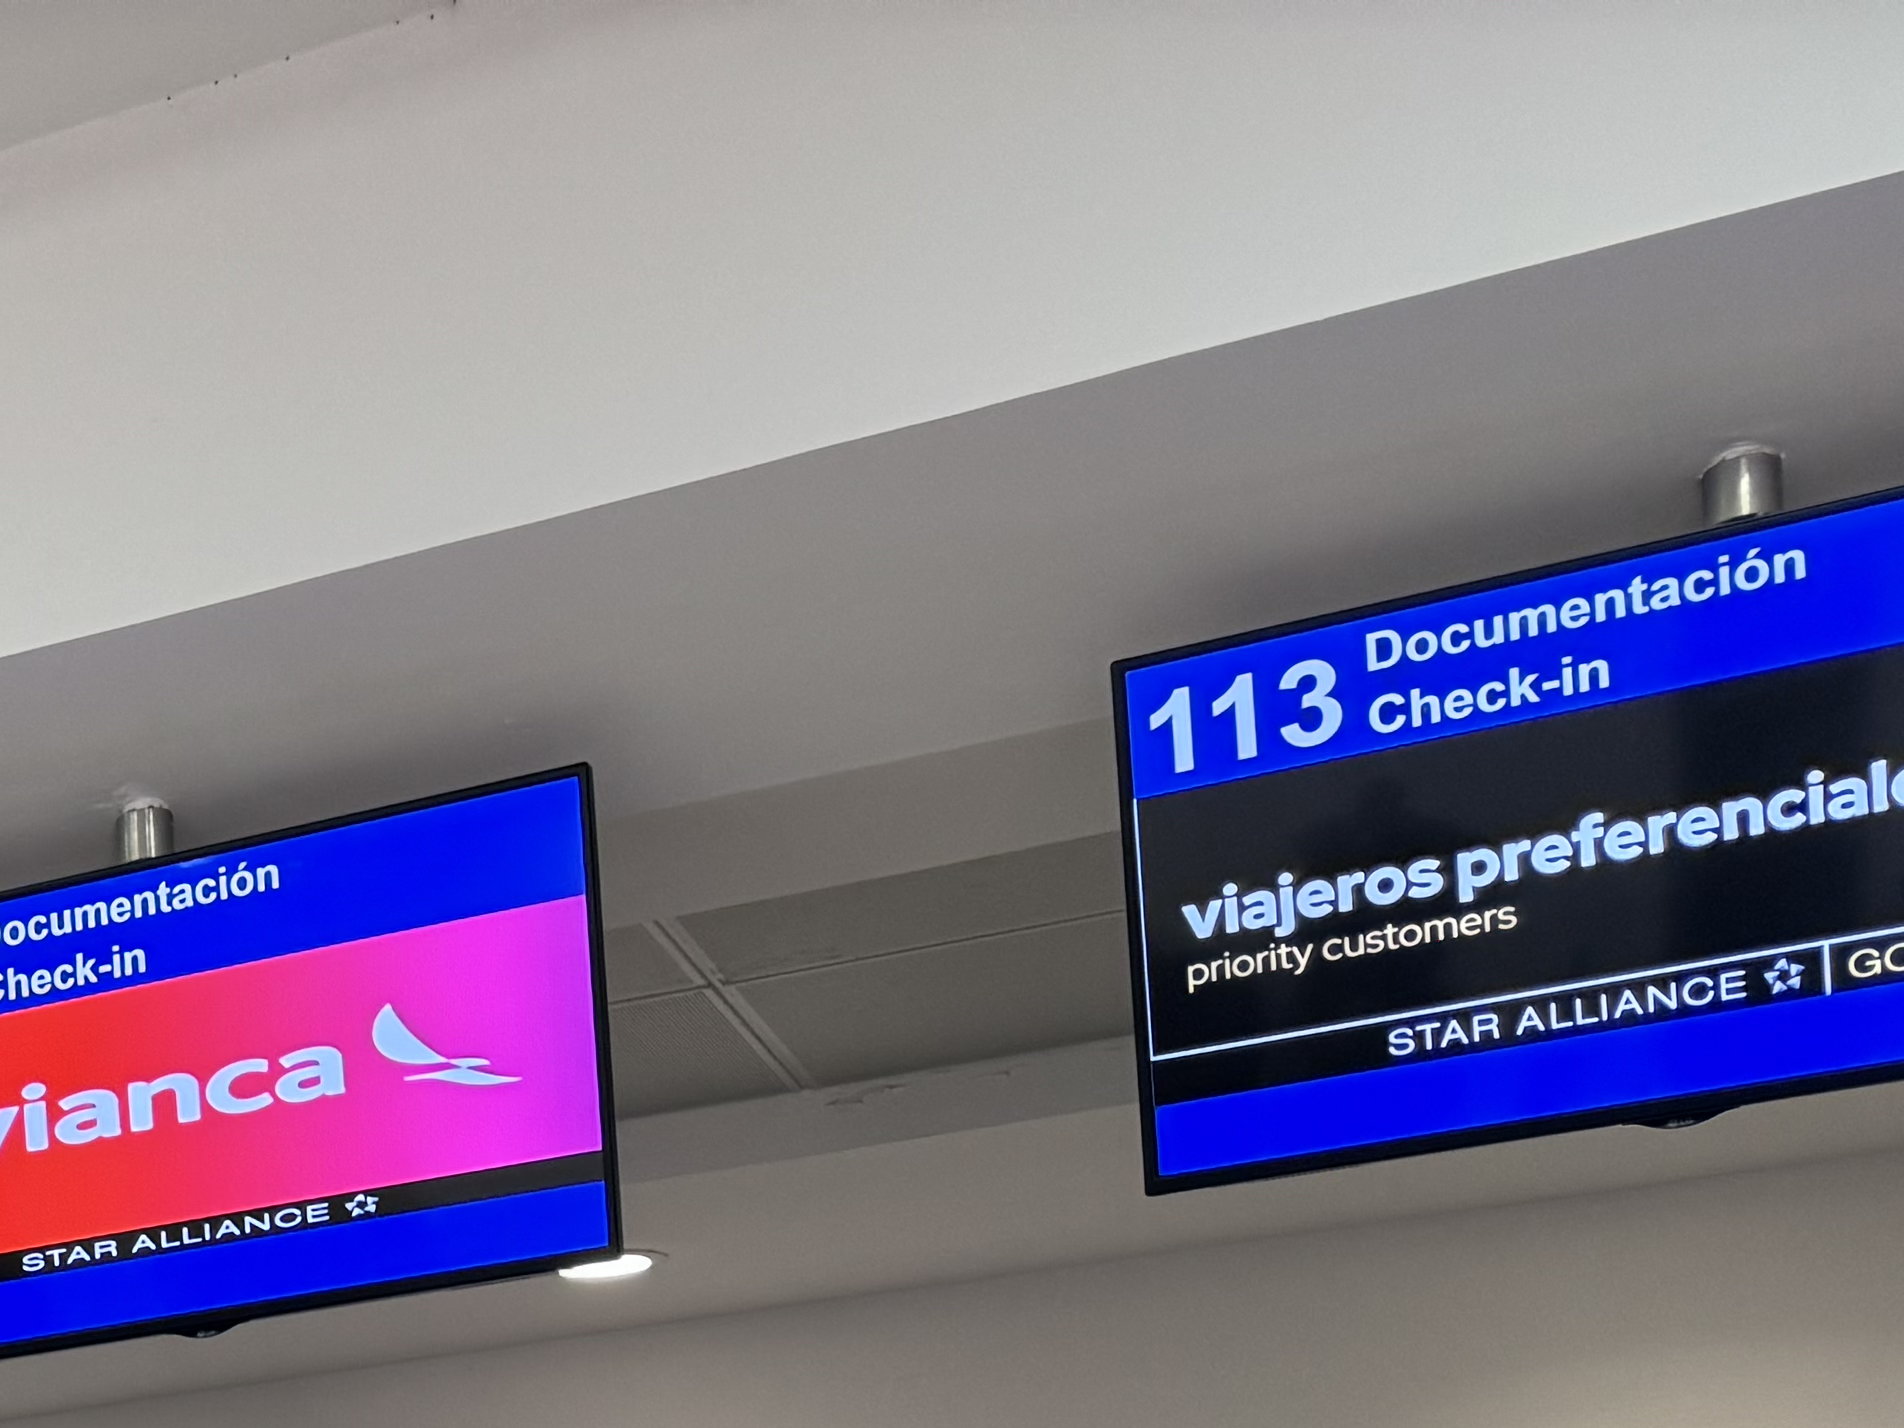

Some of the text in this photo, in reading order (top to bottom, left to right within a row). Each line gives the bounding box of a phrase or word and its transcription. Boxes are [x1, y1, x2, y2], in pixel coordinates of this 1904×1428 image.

[1365, 547, 1808, 672] Documentación
[1148, 658, 1344, 776] 113
[1369, 654, 1612, 735] Check-in
[1180, 855, 1445, 940] viajeros
[1186, 902, 1518, 994] priority customers
[1388, 969, 1747, 1058] STAR ALLIANCE
[21, 1202, 332, 1273] STAR ALLIANCE
